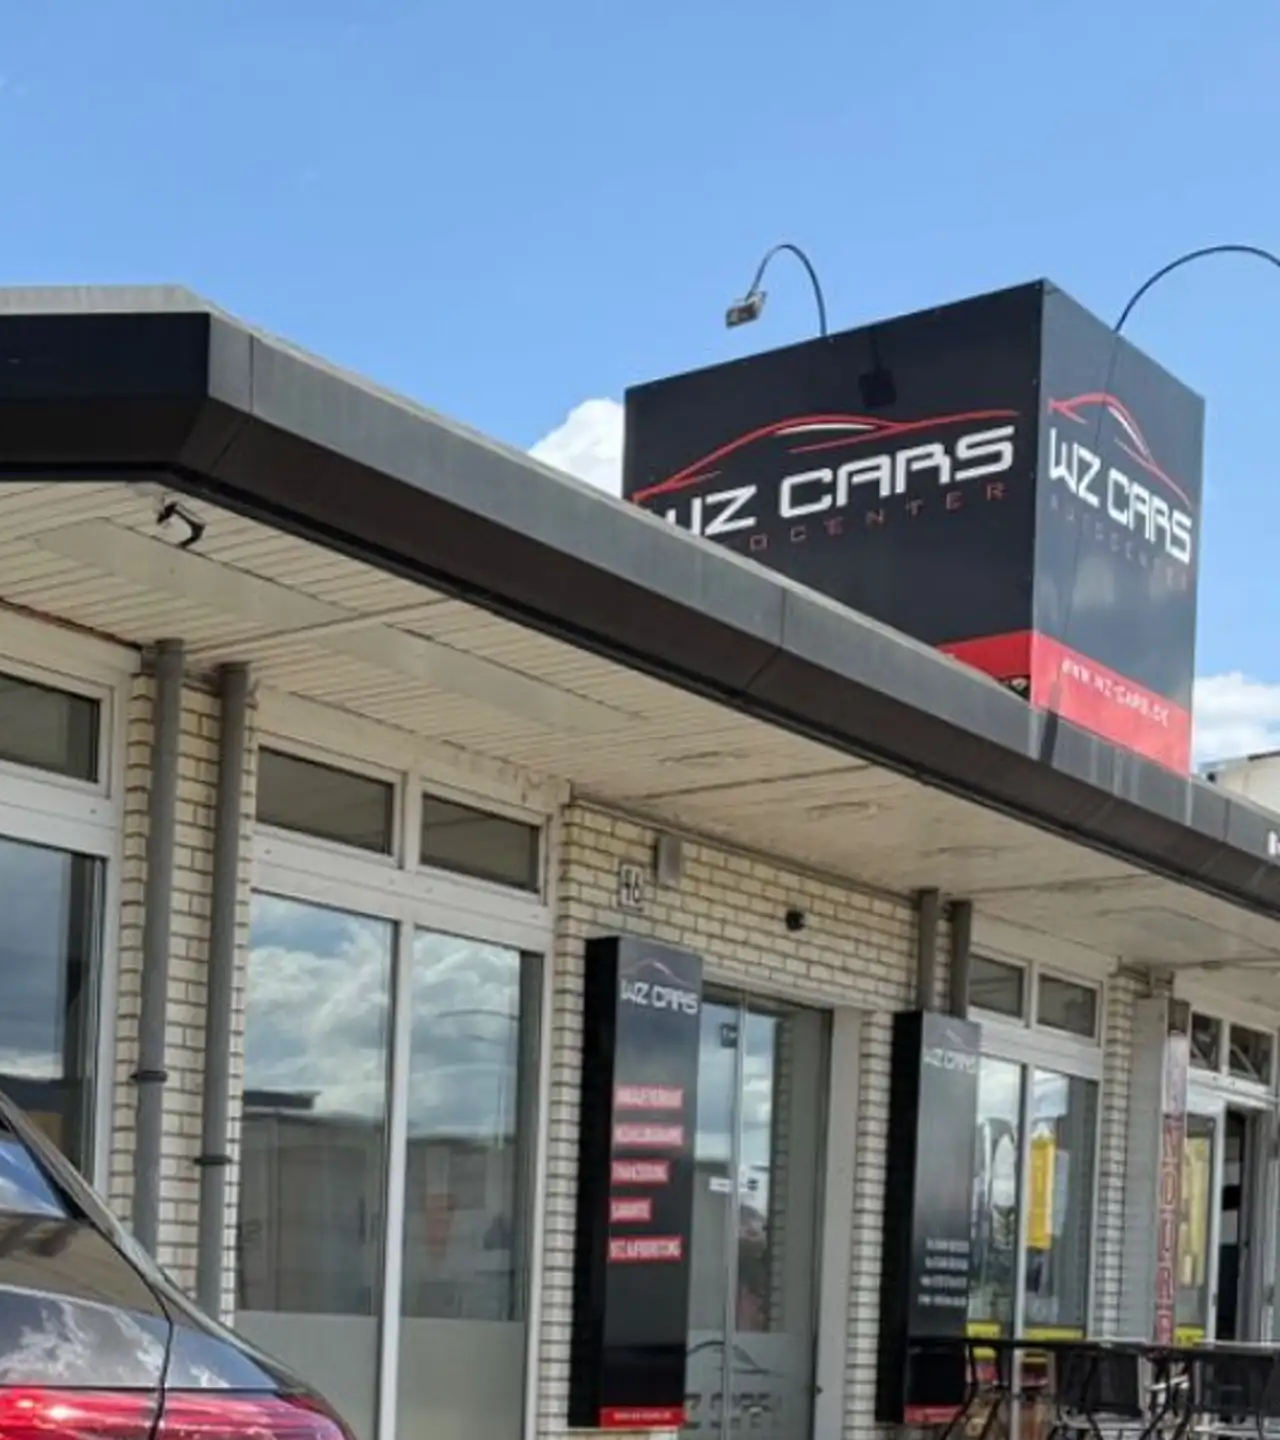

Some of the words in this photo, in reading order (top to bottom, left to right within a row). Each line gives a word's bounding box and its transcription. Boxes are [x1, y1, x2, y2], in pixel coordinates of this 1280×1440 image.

[779, 425, 1015, 519] CARS
[1048, 427, 1101, 508] WZ
[1107, 467, 1193, 567] CARS
